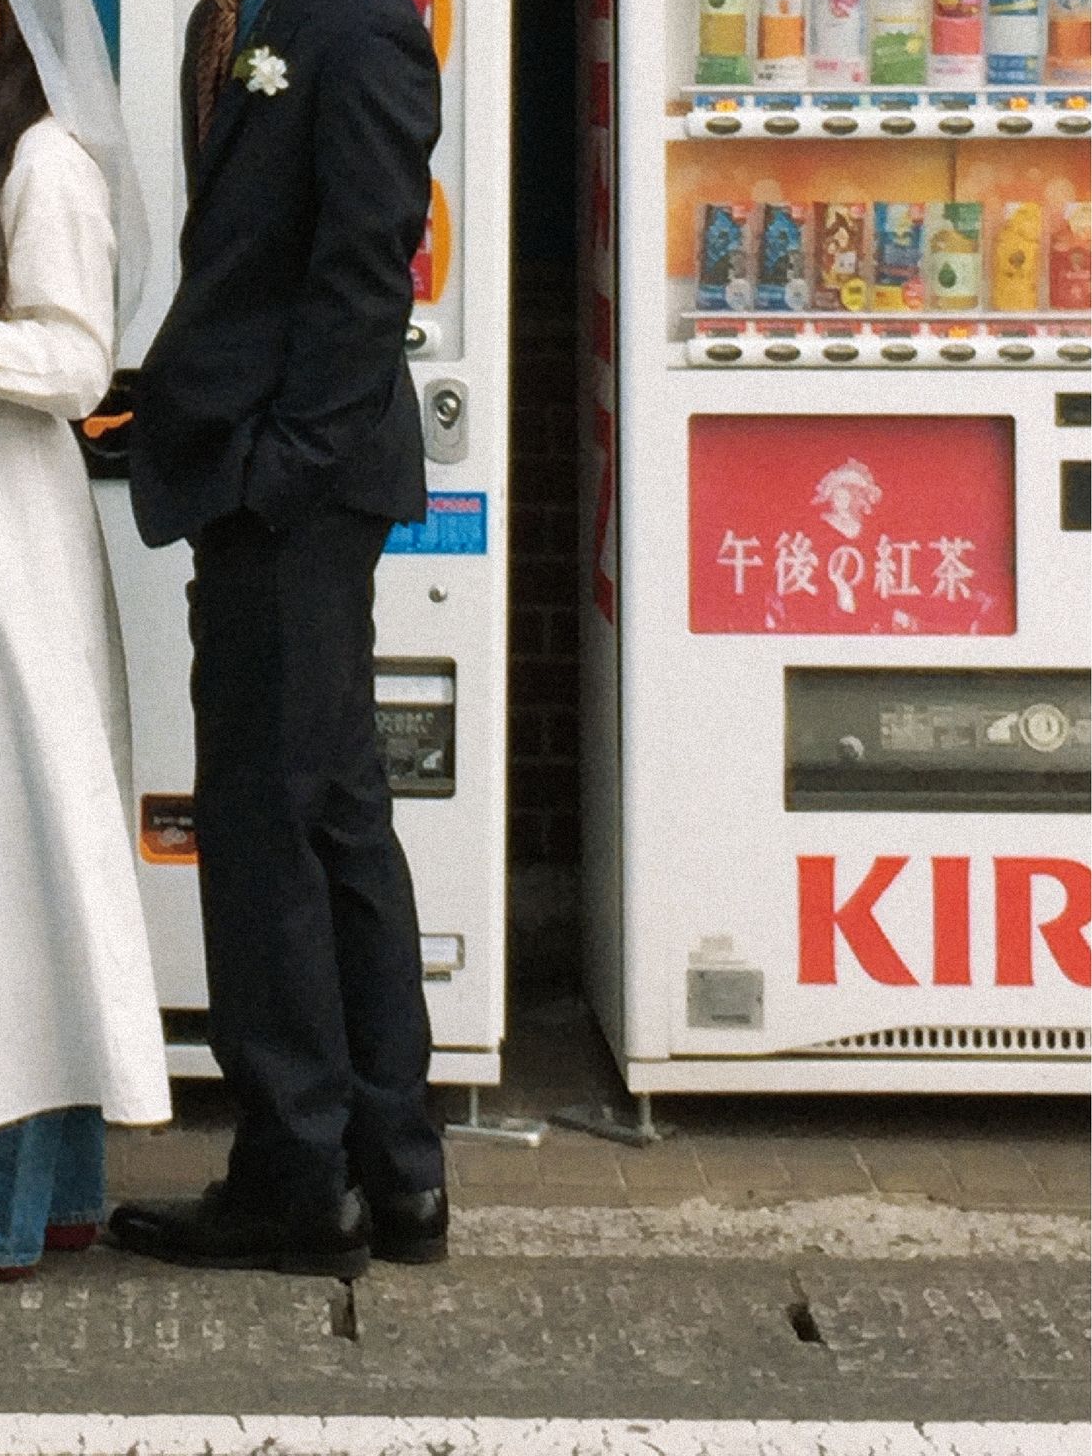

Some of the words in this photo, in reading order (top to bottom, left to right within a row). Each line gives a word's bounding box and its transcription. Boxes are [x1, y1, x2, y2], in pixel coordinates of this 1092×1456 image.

[716, 529, 975, 614] 午後の紅茶
